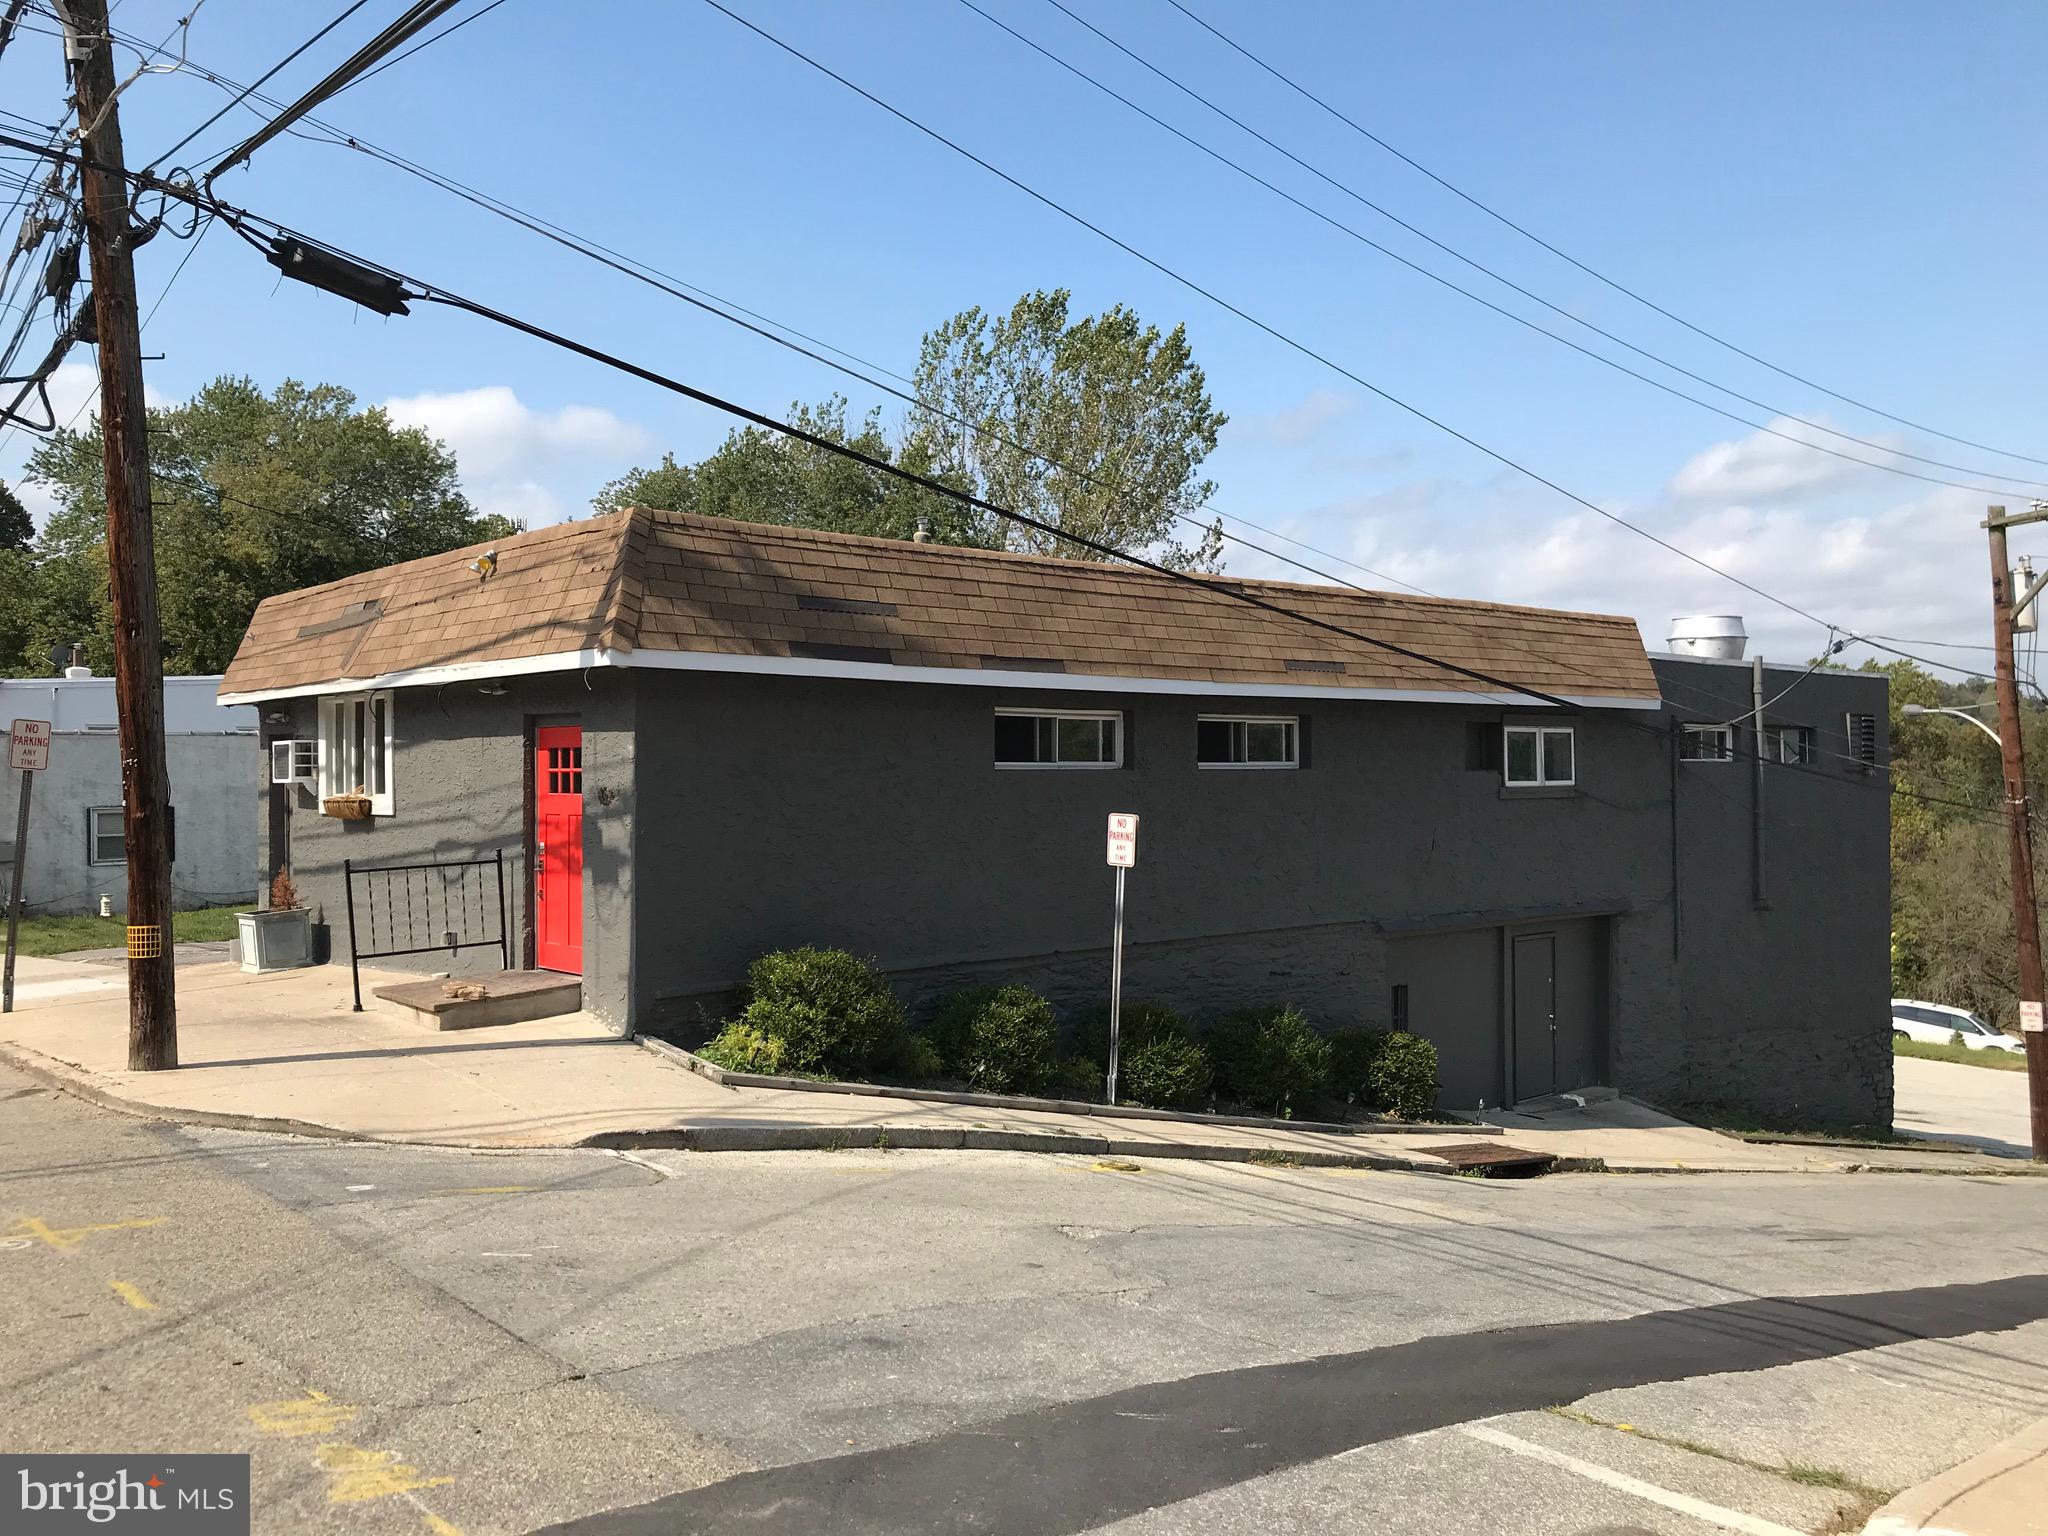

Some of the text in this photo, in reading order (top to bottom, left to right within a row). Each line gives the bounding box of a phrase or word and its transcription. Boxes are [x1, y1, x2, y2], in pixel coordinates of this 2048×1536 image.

[25, 723, 39, 734] NO
[13, 735, 48, 747] PARKING
[20, 758, 38, 767] TIME
[1117, 818, 1127, 828] NO
[1109, 830, 1134, 842] PARKING
[1115, 854, 1127, 862] TIME
